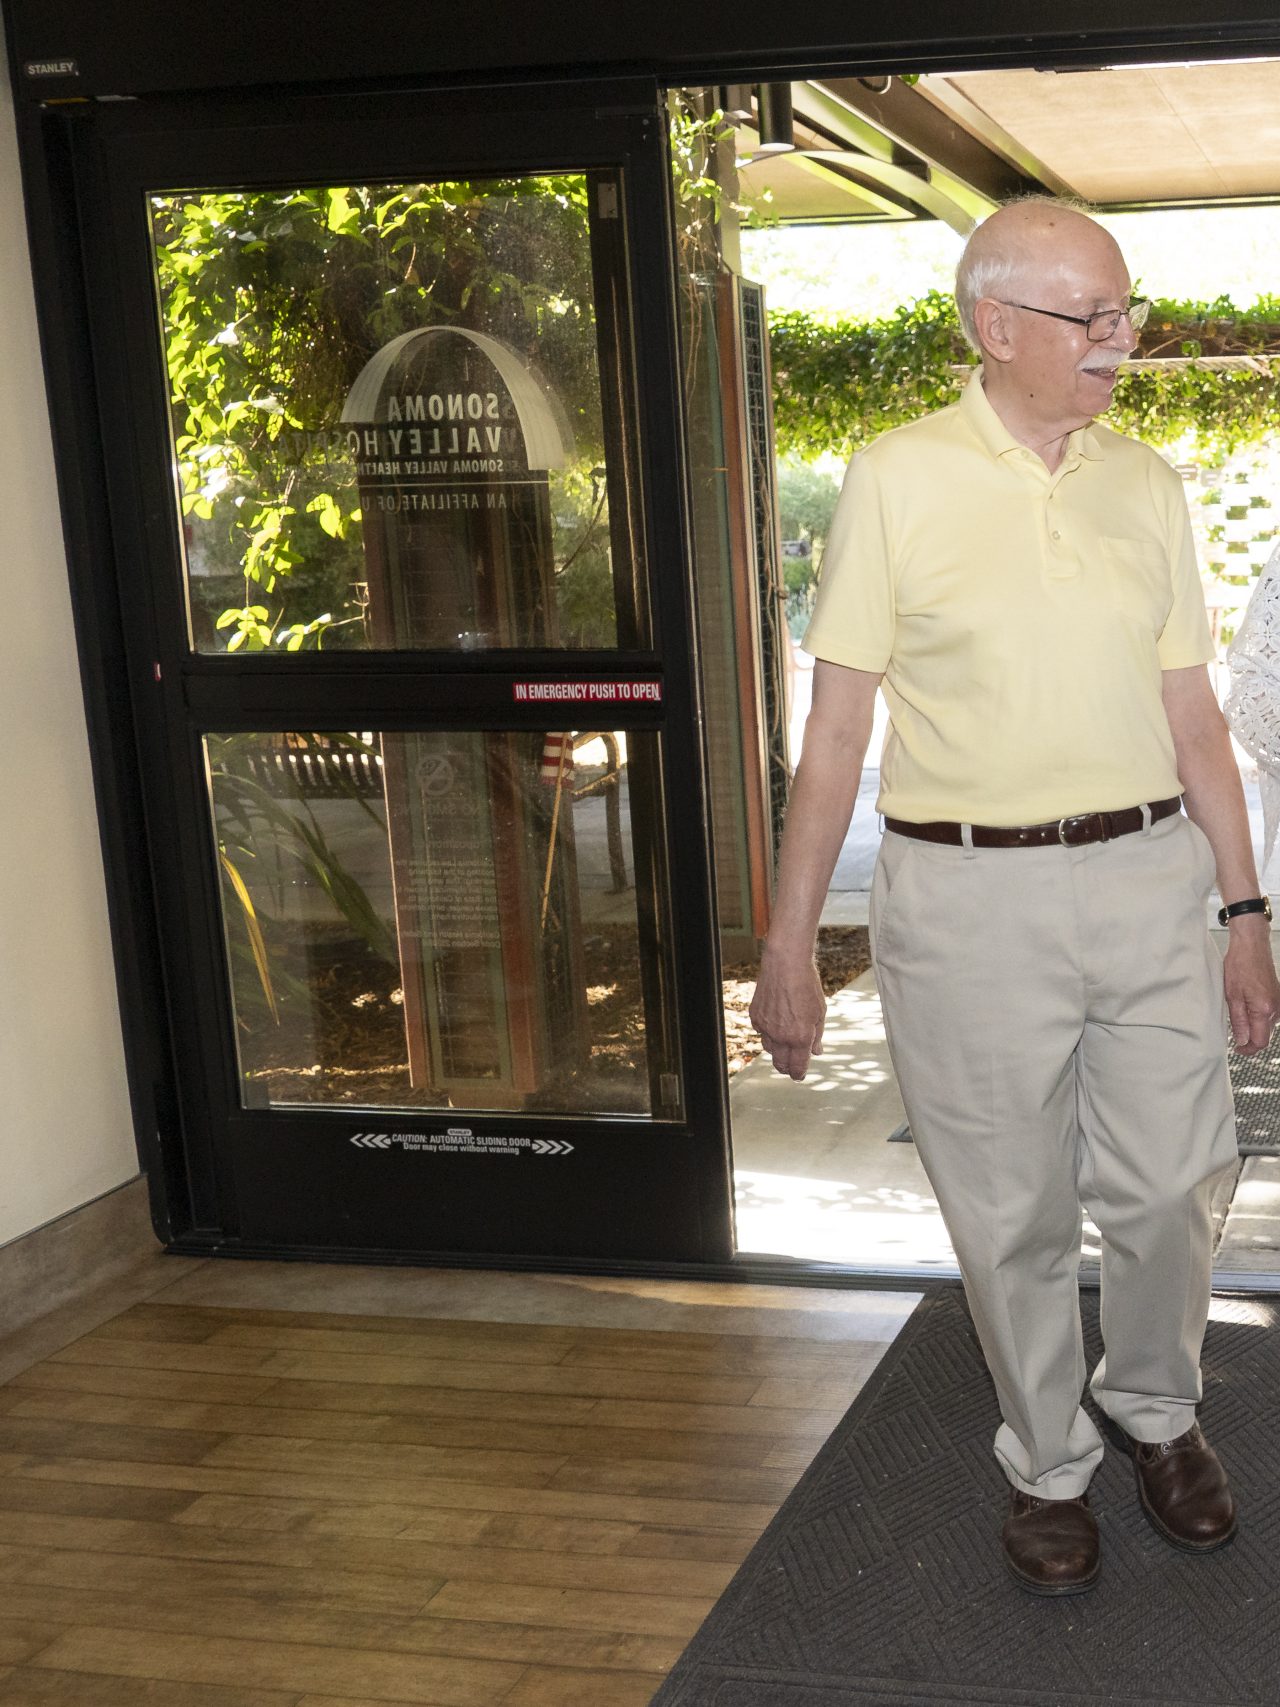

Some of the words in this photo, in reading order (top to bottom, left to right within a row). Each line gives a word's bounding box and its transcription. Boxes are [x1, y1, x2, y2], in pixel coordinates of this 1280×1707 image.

[28, 62, 74, 75] STANLEY
[516, 684, 527, 699] IN
[529, 684, 587, 699] EMERGENCY
[589, 684, 616, 699] PUSH
[617, 684, 631, 699] TO
[632, 683, 660, 699] OPEN
[392, 1134, 428, 1143] CAUTION:
[430, 1135, 475, 1145] AUTOMATIC
[476, 1136, 508, 1146] SLIDING
[509, 1138, 531, 1147] DOOR
[403, 1142, 421, 1150] Door
[421, 1144, 437, 1152] may
[438, 1143, 458, 1152] close
[459, 1144, 488, 1152] without
[489, 1146, 520, 1155] warning
